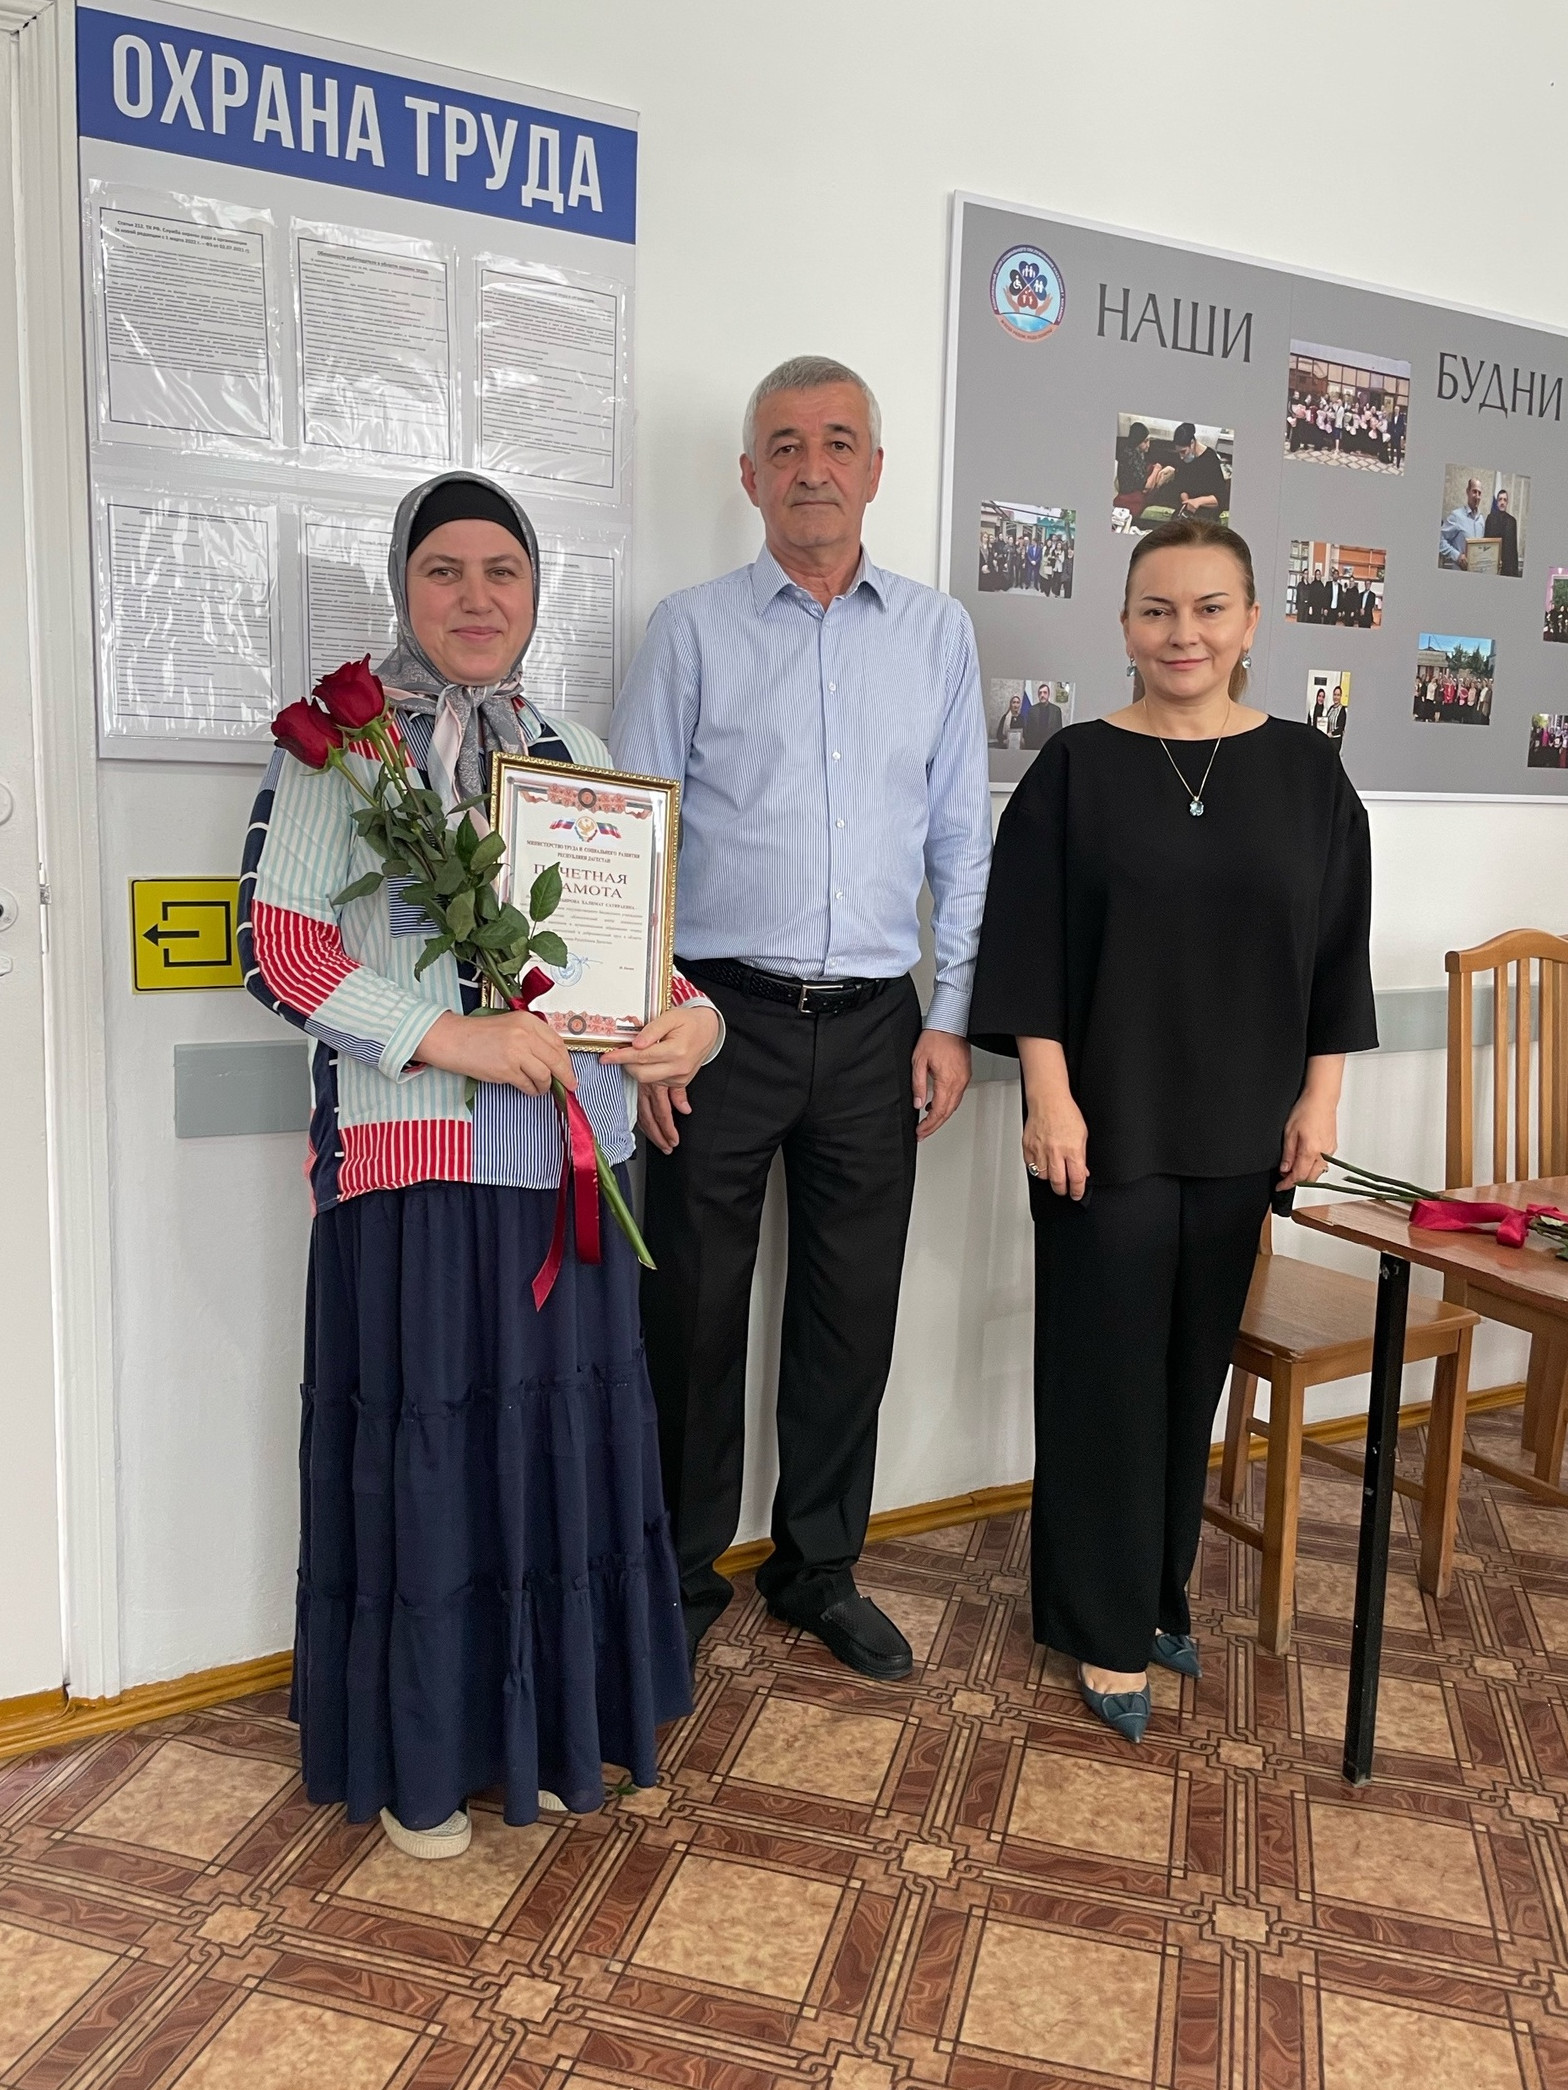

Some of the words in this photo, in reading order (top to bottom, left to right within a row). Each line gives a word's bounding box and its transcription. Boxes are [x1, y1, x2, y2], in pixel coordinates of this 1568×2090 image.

[112, 33, 385, 168] ОХРАНА
[404, 95, 604, 214] ТРУДА
[1096, 282, 1253, 364] НАШИ
[1436, 351, 1565, 422] БУДНИ
[526, 840, 564, 850] МИНИСТЕРСТВО
[584, 847, 617, 856] СОЦИАЛЬНОГО
[557, 852, 587, 860] РЕСПУБЛИКИ
[588, 856, 610, 864] ДАГЕСТАН
[533, 863, 627, 884] ПЧЕТНАЯ
